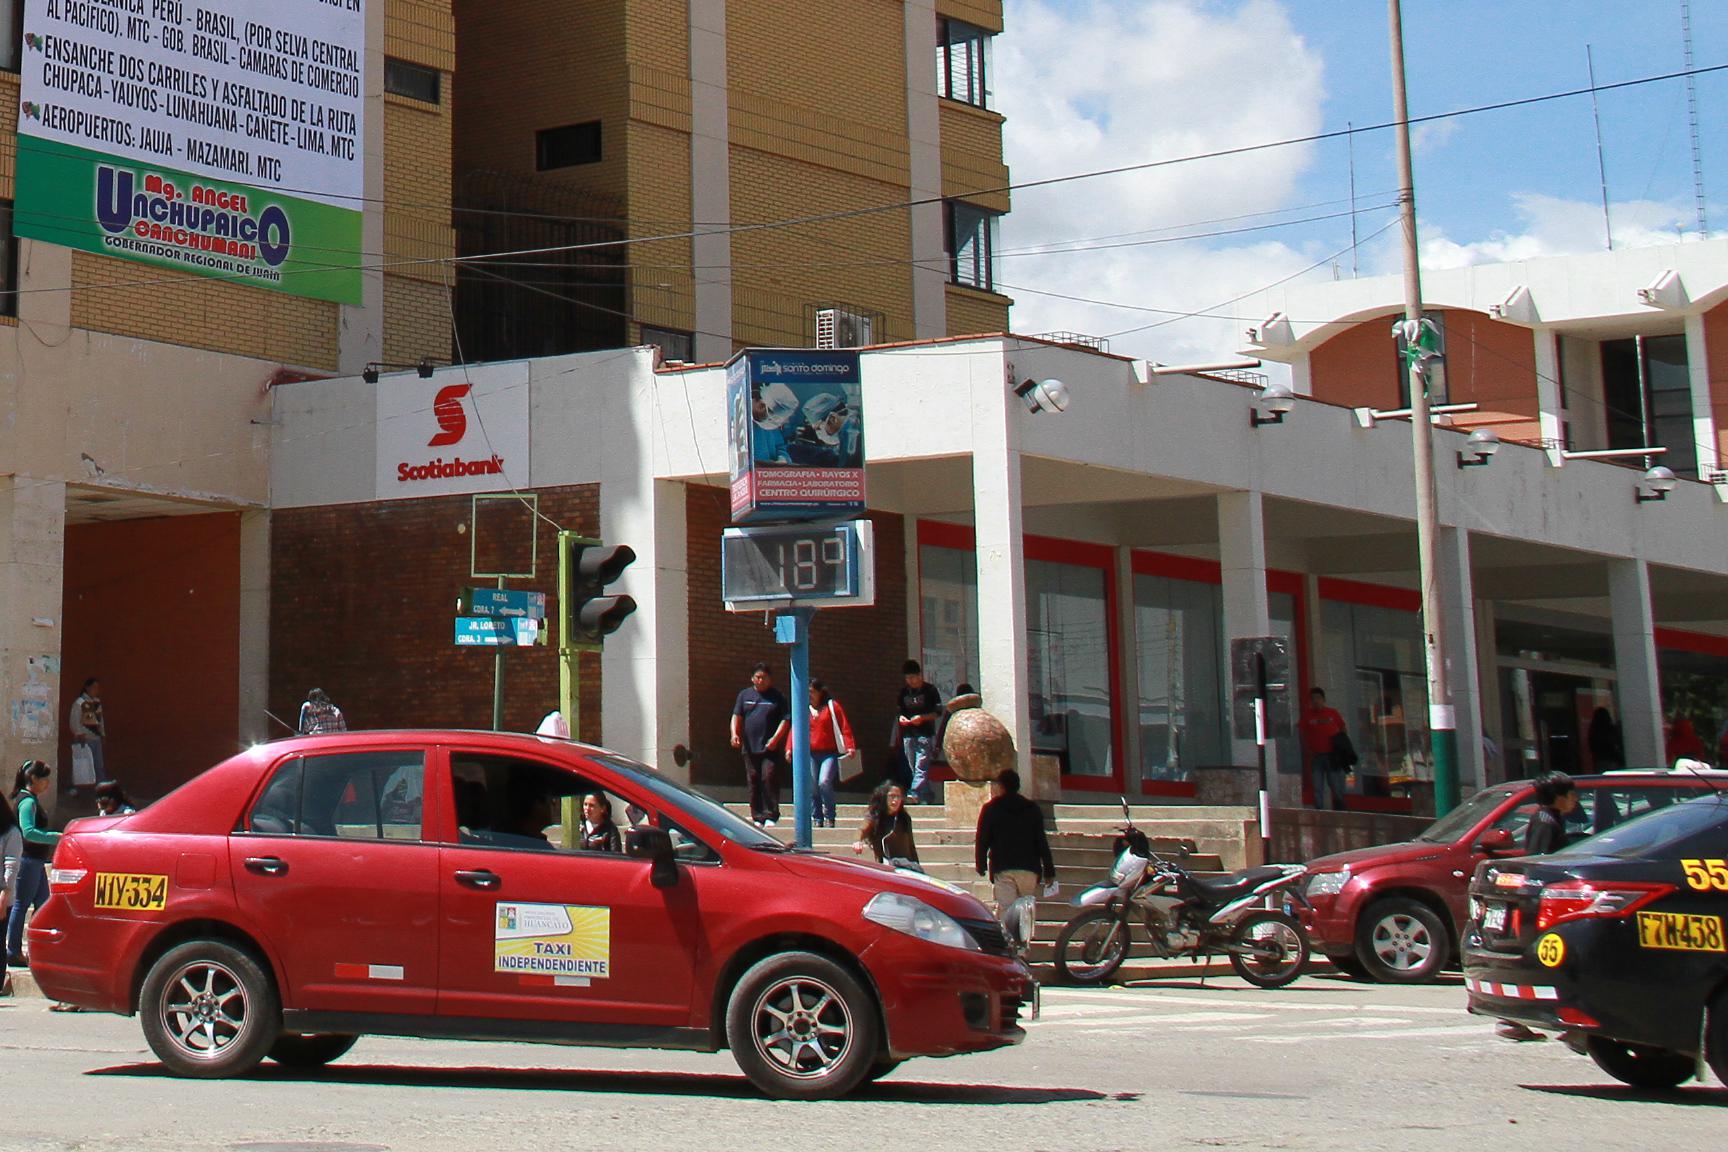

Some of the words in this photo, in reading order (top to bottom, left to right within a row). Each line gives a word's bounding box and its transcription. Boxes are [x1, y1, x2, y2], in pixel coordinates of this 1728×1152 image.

[64, 0, 122, 40] PACÍFICO).
[162, 25, 186, 54] GOB.
[192, 33, 229, 65] BRASIL
[307, 63, 358, 98] COMERCIO
[196, 7, 240, 45] BRASIL,
[244, 20, 271, 52] (POR
[275, 28, 308, 60] SELVA
[312, 38, 359, 73] CENTRAL
[44, 34, 114, 76] ENSANCHE
[148, 60, 206, 99] CARRILES
[222, 79, 286, 118] ASFALTADO
[327, 106, 356, 136] RUTA
[42, 103, 136, 148] AEROPUERTOS:
[139, 125, 173, 157] JAUJA
[187, 137, 252, 175] MAZAMARI.
[398, 455, 504, 481] Scotiabank
[759, 489, 797, 497] CENTRO
[534, 942, 571, 954] TAXI
